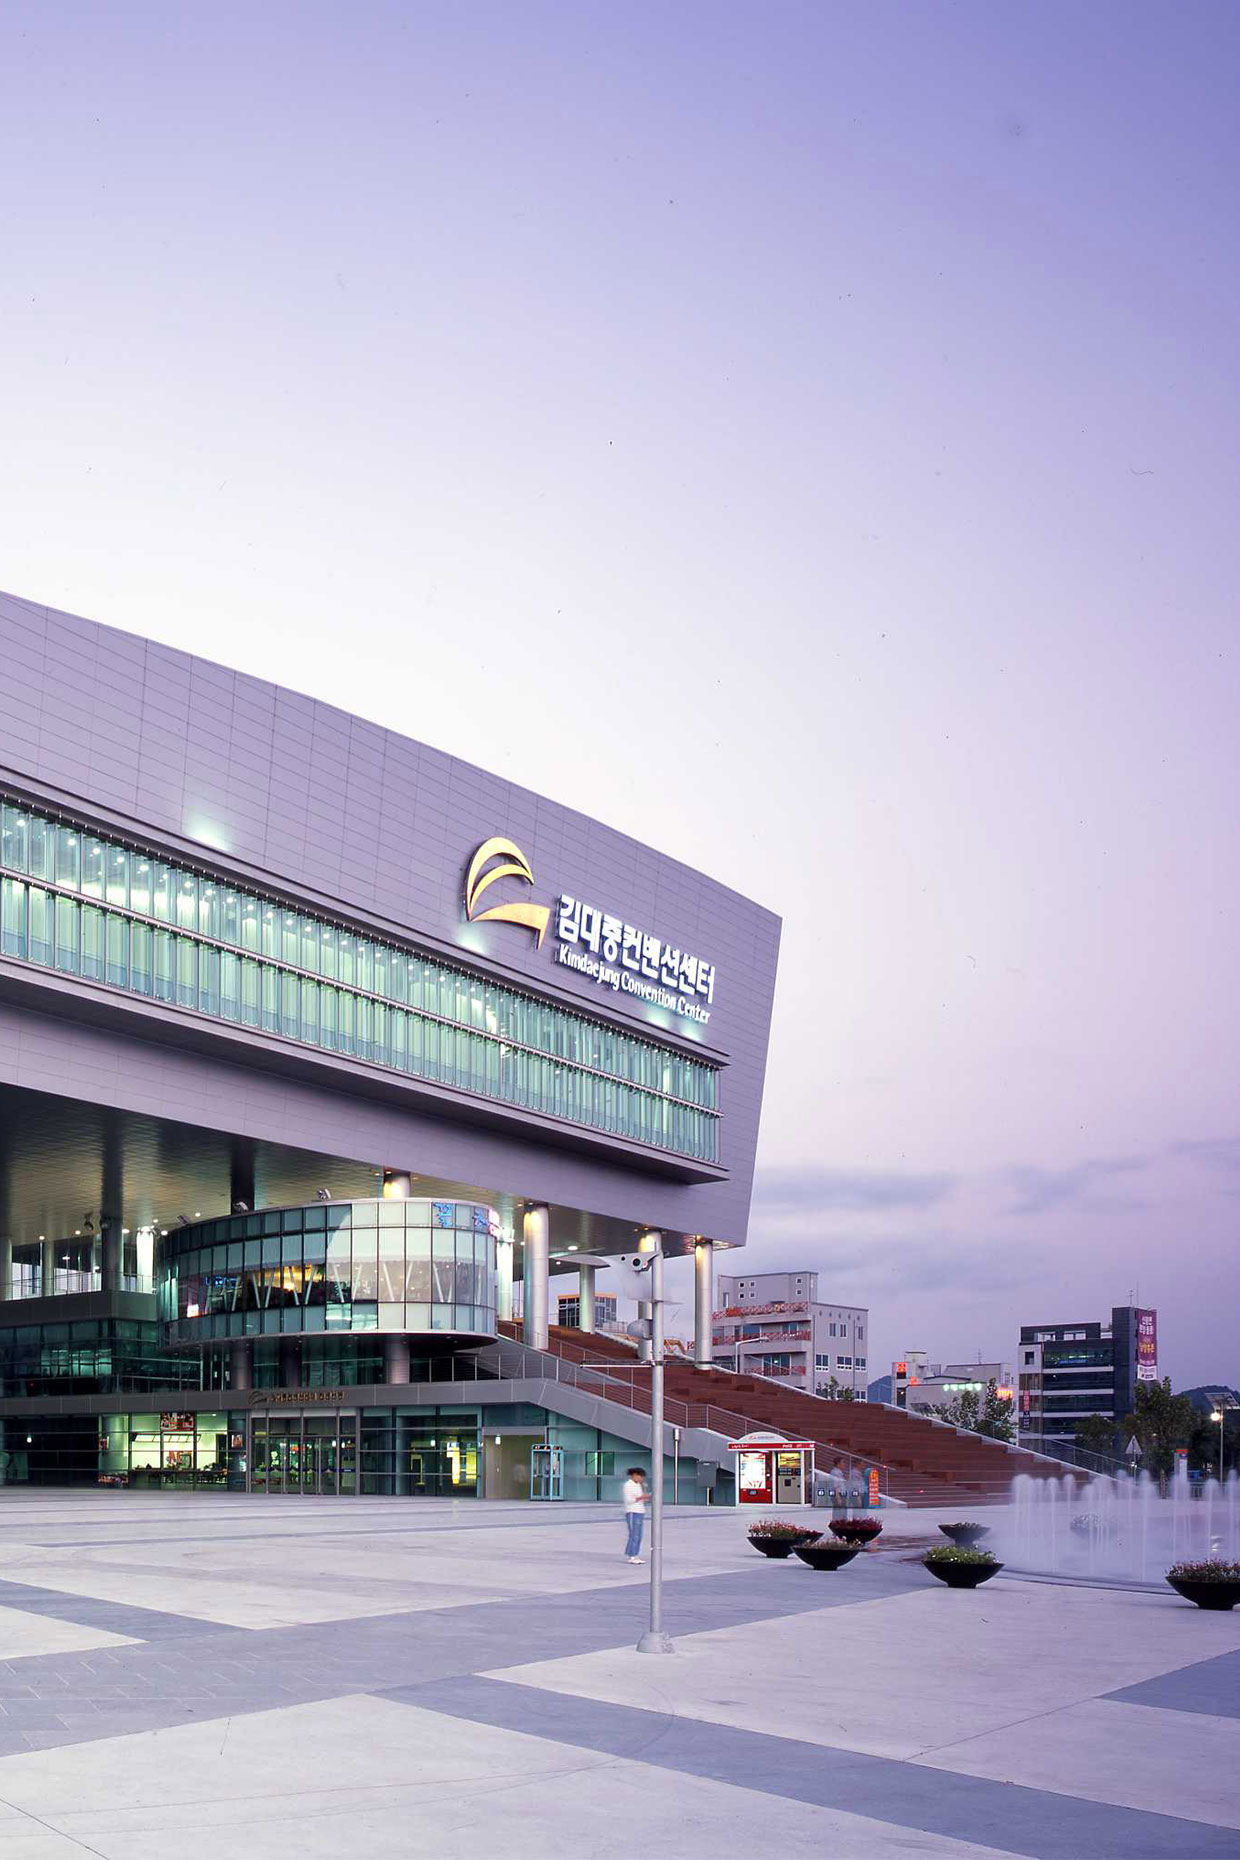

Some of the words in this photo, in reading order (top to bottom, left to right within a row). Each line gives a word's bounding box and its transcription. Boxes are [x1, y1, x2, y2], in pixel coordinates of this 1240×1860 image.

[559, 944, 620, 992] Kimdaejung
[621, 971, 677, 1011] Convention
[677, 996, 711, 1025] Center
